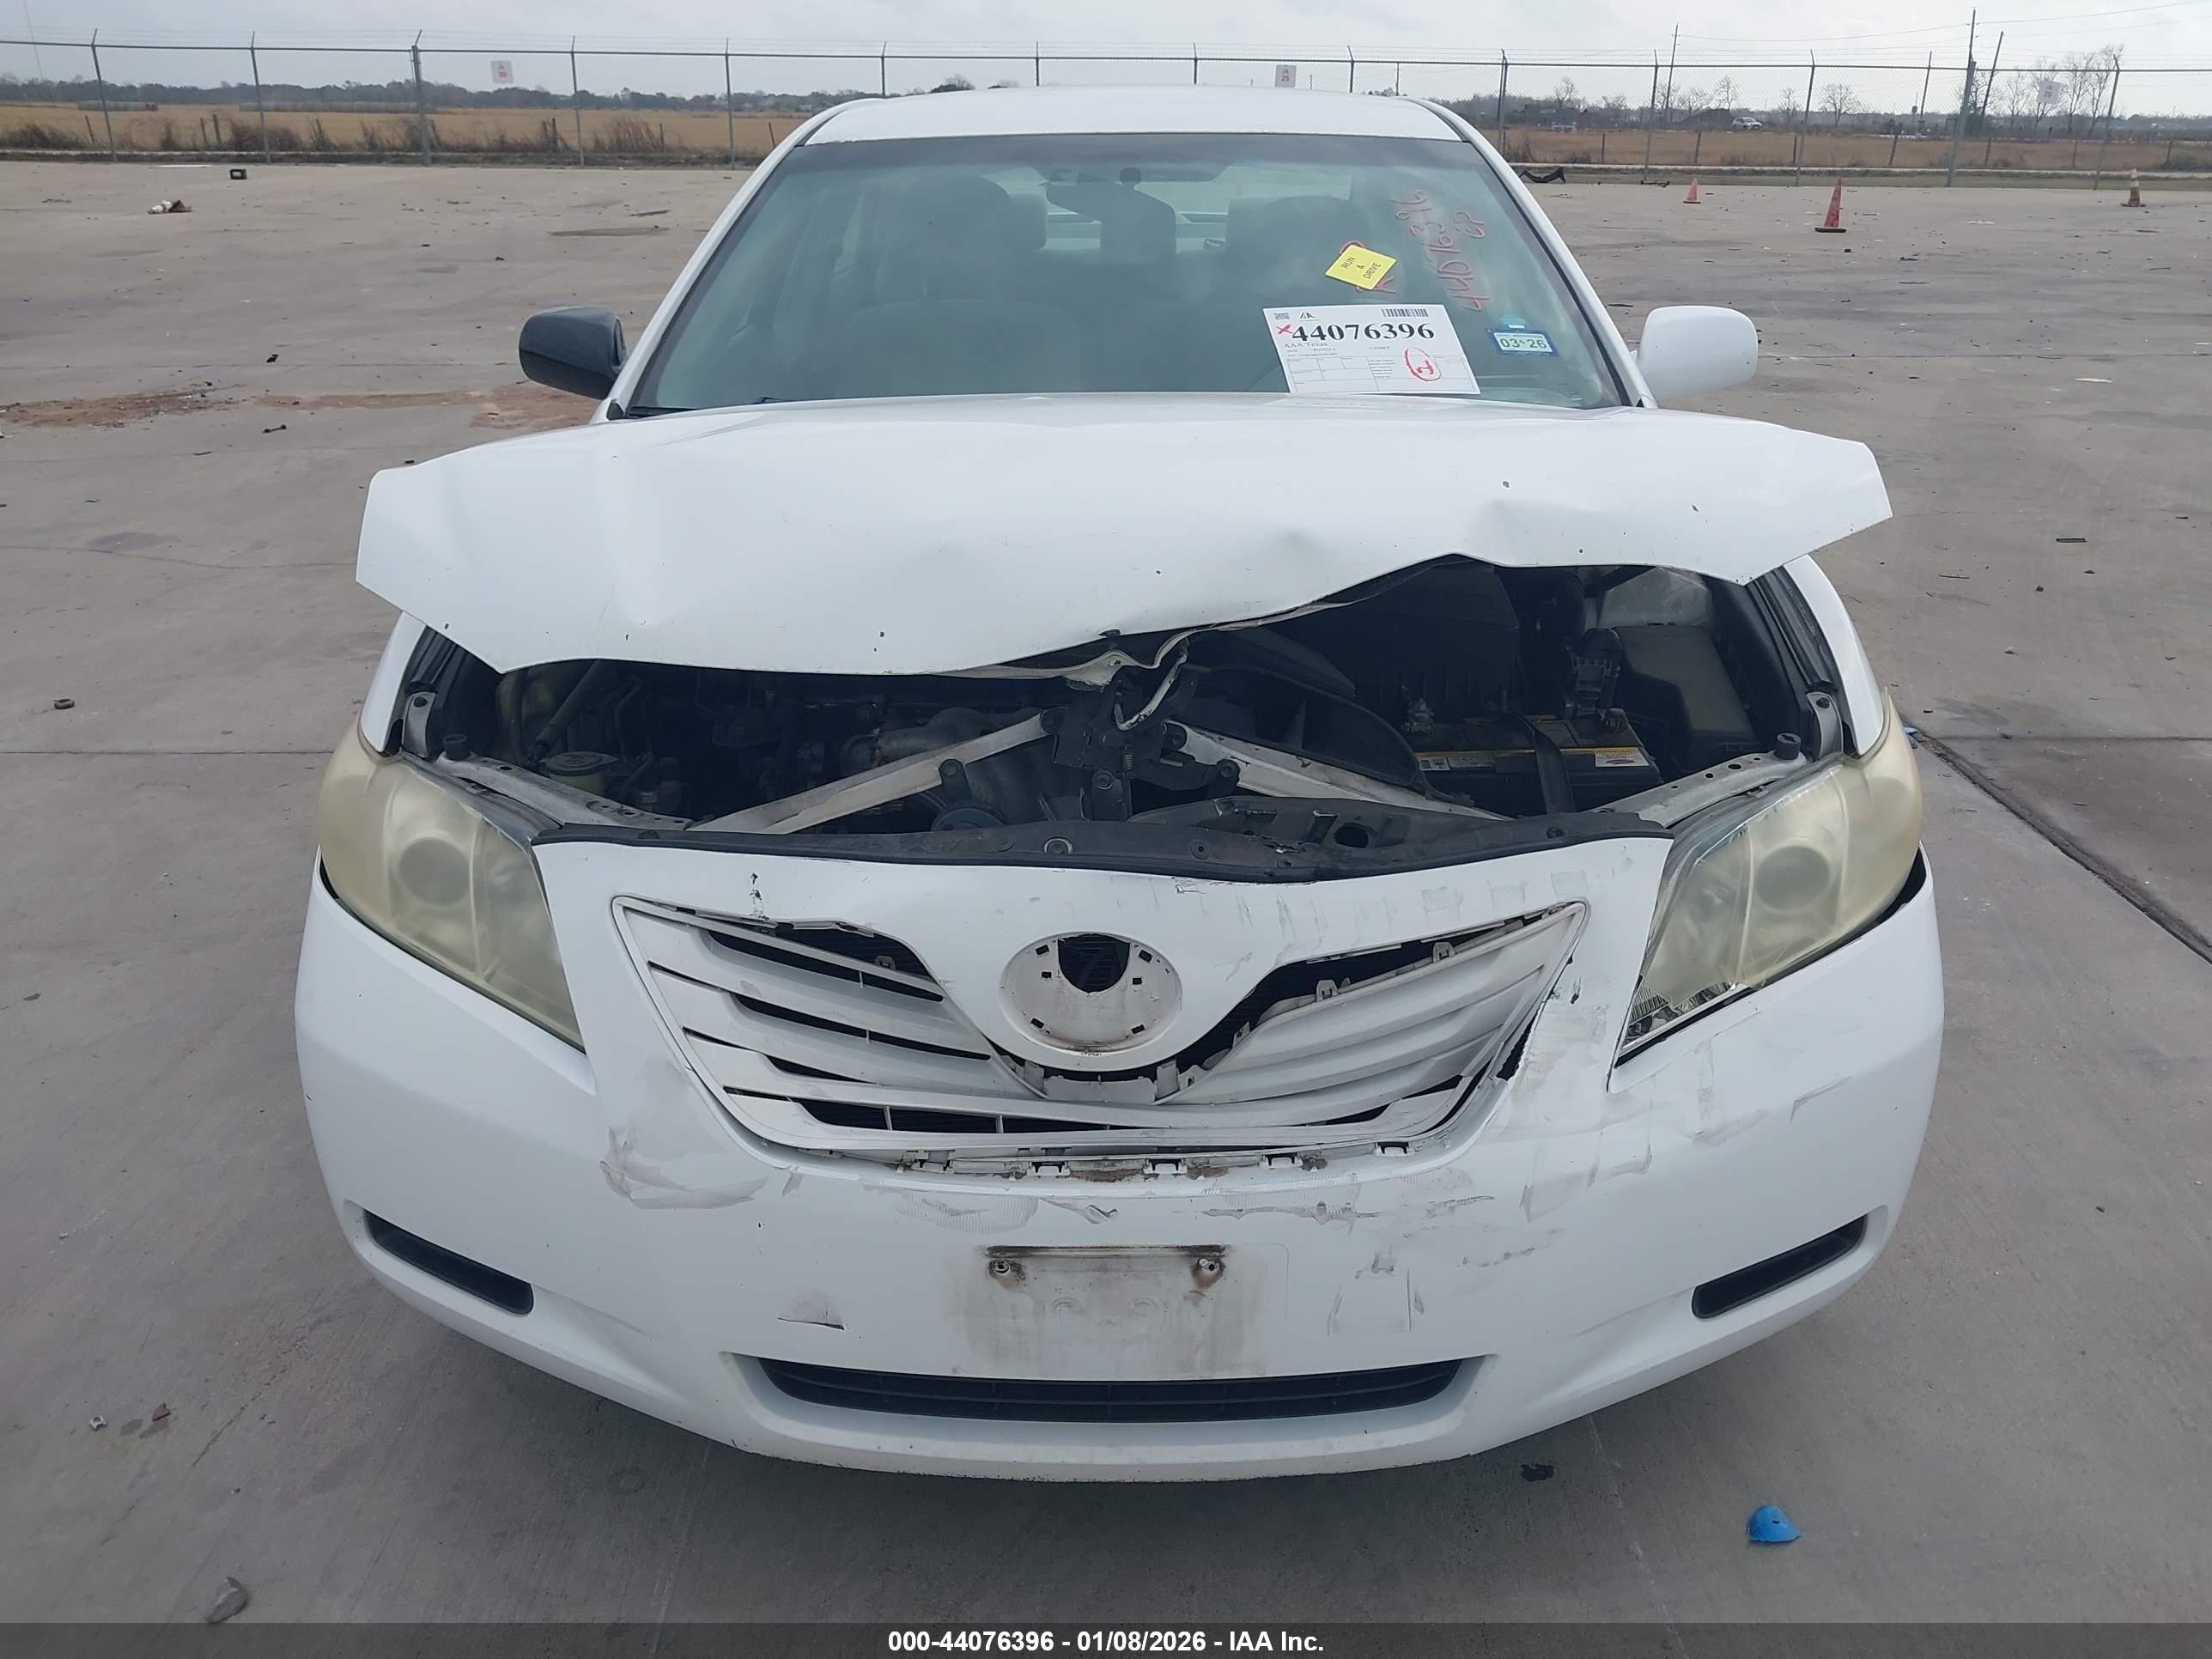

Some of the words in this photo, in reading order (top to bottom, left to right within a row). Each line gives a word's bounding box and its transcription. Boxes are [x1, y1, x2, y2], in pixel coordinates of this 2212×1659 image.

[1341, 257, 1357, 269] RUN
[1363, 262, 1382, 279] DRIVE
[1291, 323, 1435, 342] 44076396
[1499, 338, 1520, 348] 03
[1527, 339, 1547, 349] 26
